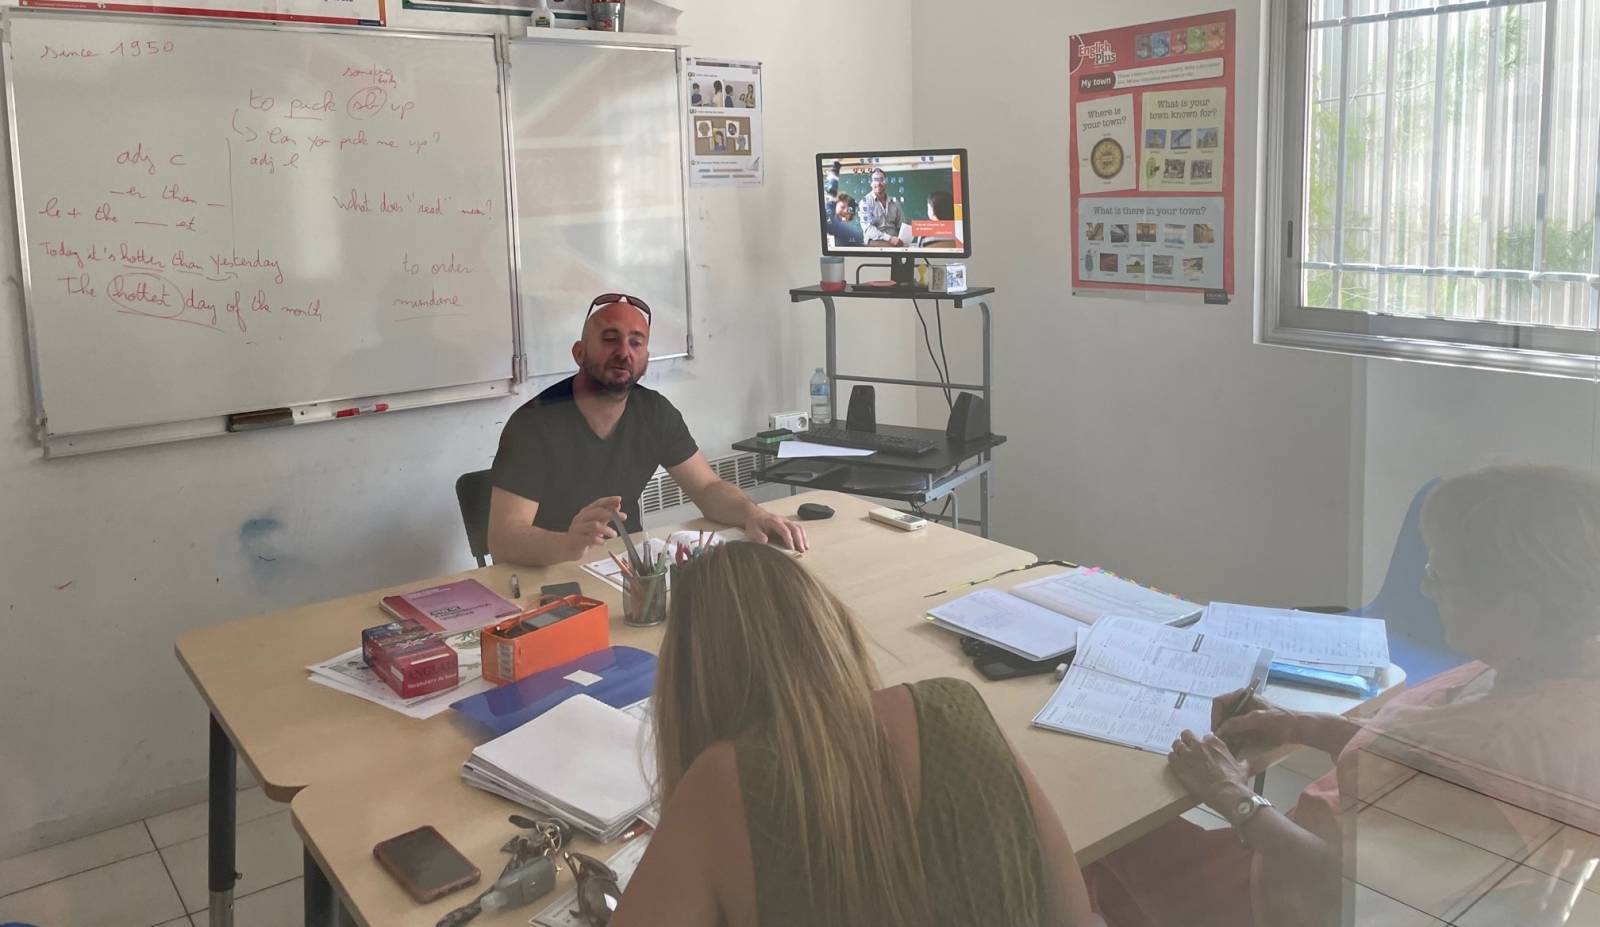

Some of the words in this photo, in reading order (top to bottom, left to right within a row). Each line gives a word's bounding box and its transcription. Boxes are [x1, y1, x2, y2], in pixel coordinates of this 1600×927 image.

[110, 40, 174, 56] 1950
[1079, 40, 1112, 59] English
[1094, 52, 1117, 65] Plus
[1081, 78, 1093, 88] My
[1093, 77, 1112, 87] town
[249, 88, 275, 111] to
[290, 90, 336, 117] pick
[391, 100, 415, 120] up
[1088, 109, 1113, 119] Where
[1114, 107, 1121, 115] is
[1157, 99, 1179, 109] What
[1181, 99, 1188, 108] is
[1189, 99, 1210, 109] your
[1082, 121, 1101, 131] your
[1102, 116, 1127, 128] town?
[1150, 112, 1169, 120] town
[1171, 110, 1198, 119] known
[1199, 108, 1217, 118] for?
[339, 130, 369, 149] pick
[116, 143, 156, 175] adj
[250, 152, 275, 174] adj
[333, 188, 372, 213] What
[94, 203, 118, 223] the
[1093, 206, 1114, 215] What
[1115, 206, 1121, 215] is
[1122, 206, 1145, 215] there
[1147, 206, 1155, 215] in
[1156, 207, 1178, 216] your
[1180, 206, 1207, 215] town?
[38, 240, 83, 268] Today
[120, 244, 165, 268] hotter
[172, 252, 203, 270] than
[209, 247, 284, 284] yesterday
[402, 253, 420, 275] to
[431, 253, 474, 276] order
[57, 275, 97, 298] The
[186, 287, 217, 325] day
[226, 291, 247, 334] of
[251, 288, 272, 313] the
[281, 298, 323, 323] month
